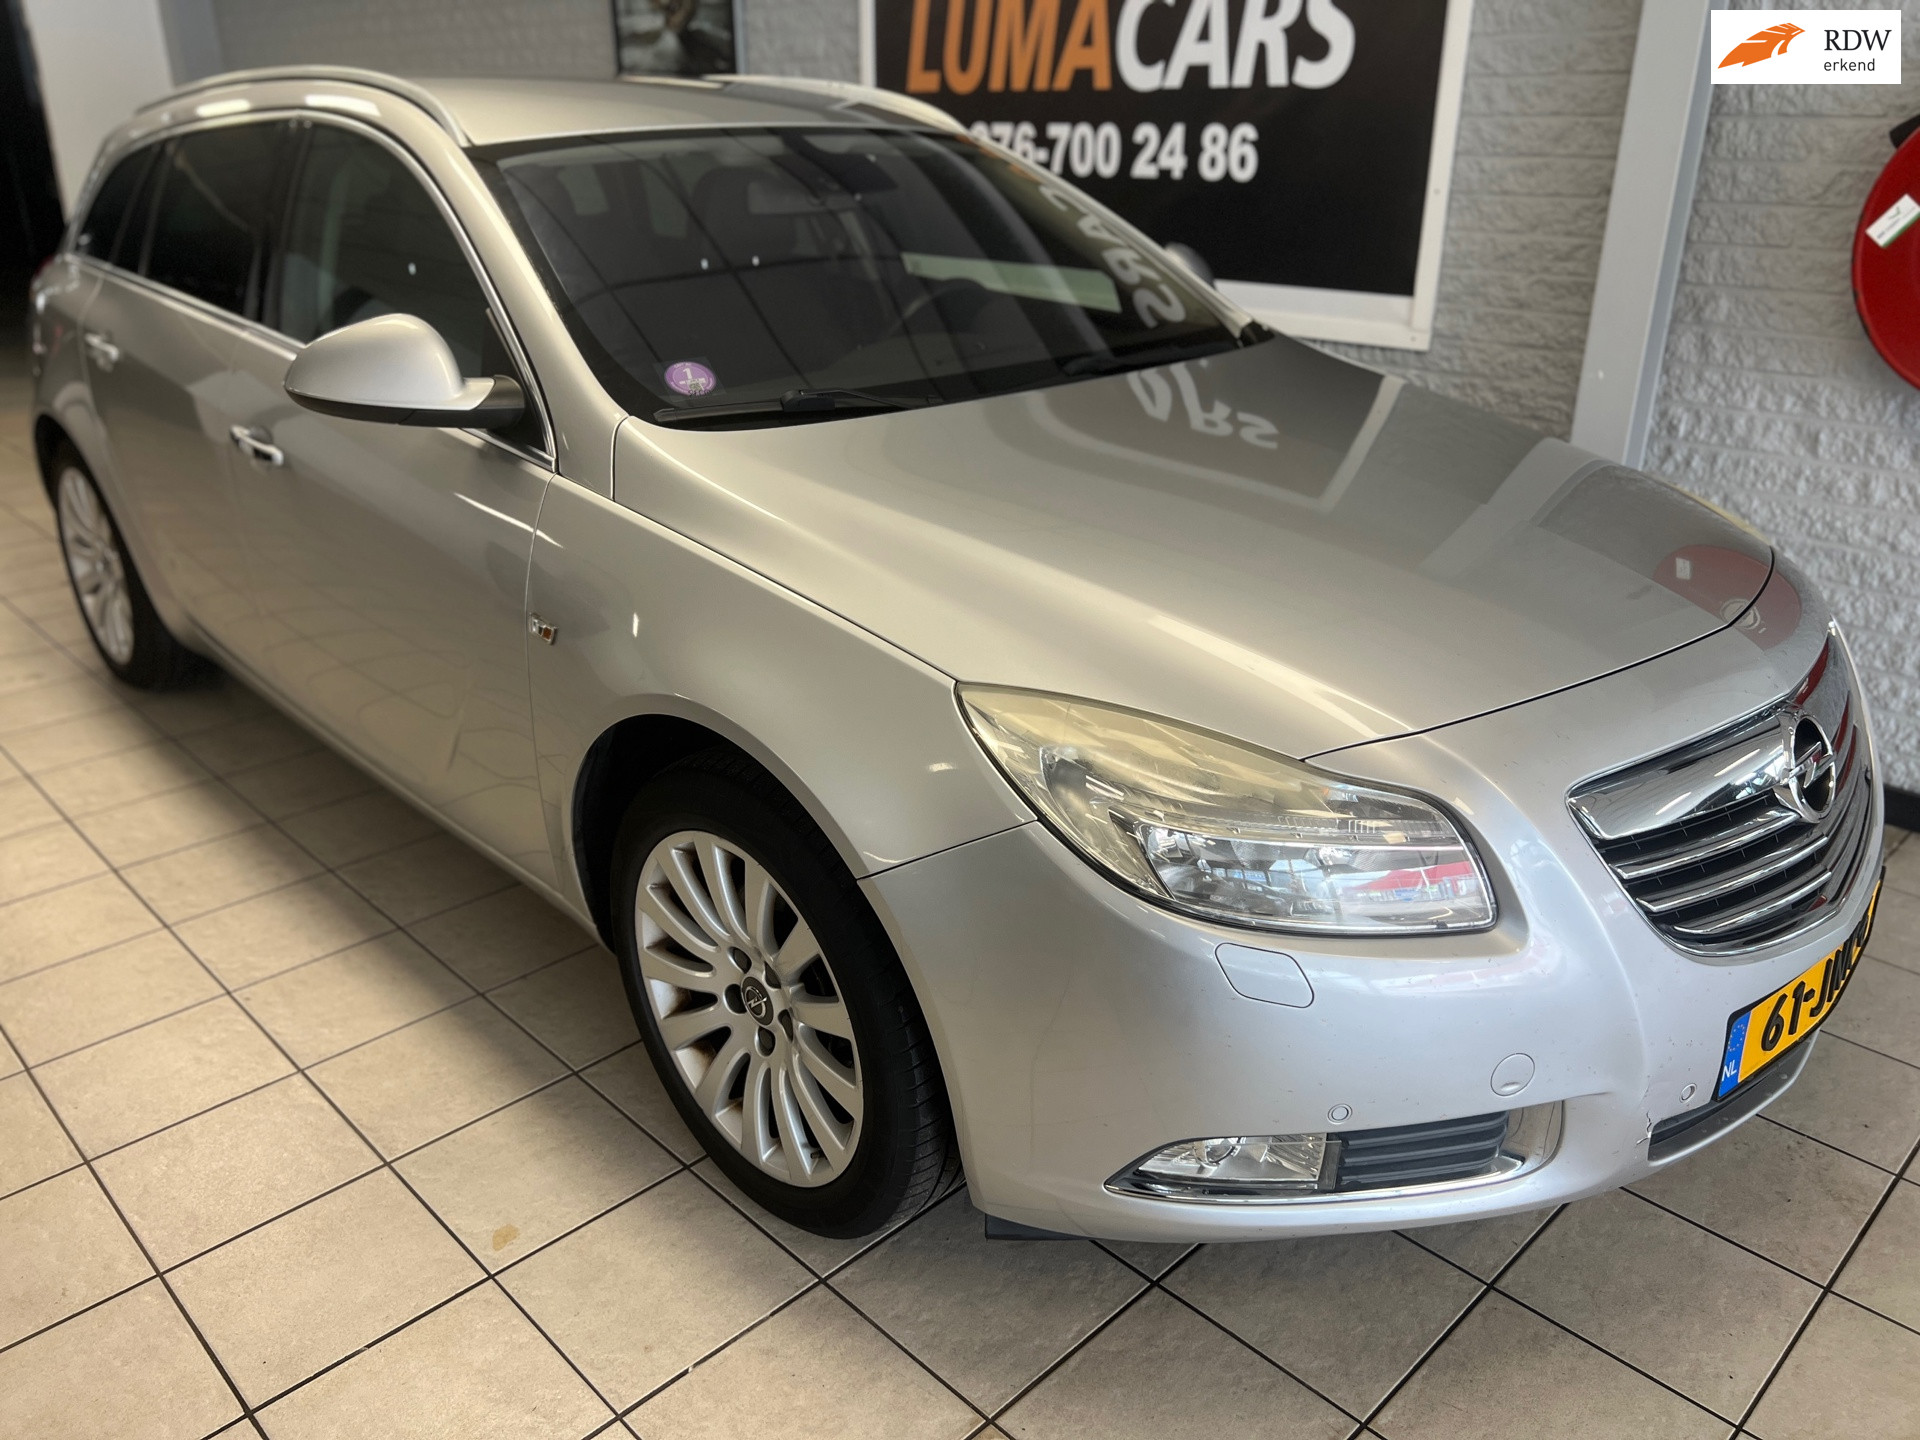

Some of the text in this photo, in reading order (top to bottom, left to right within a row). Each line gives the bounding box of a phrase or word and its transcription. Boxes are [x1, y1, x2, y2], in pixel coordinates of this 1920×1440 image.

[1130, 122, 1187, 180] 24
[1198, 122, 1260, 183] 86
[1721, 1059, 1738, 1082] NL
